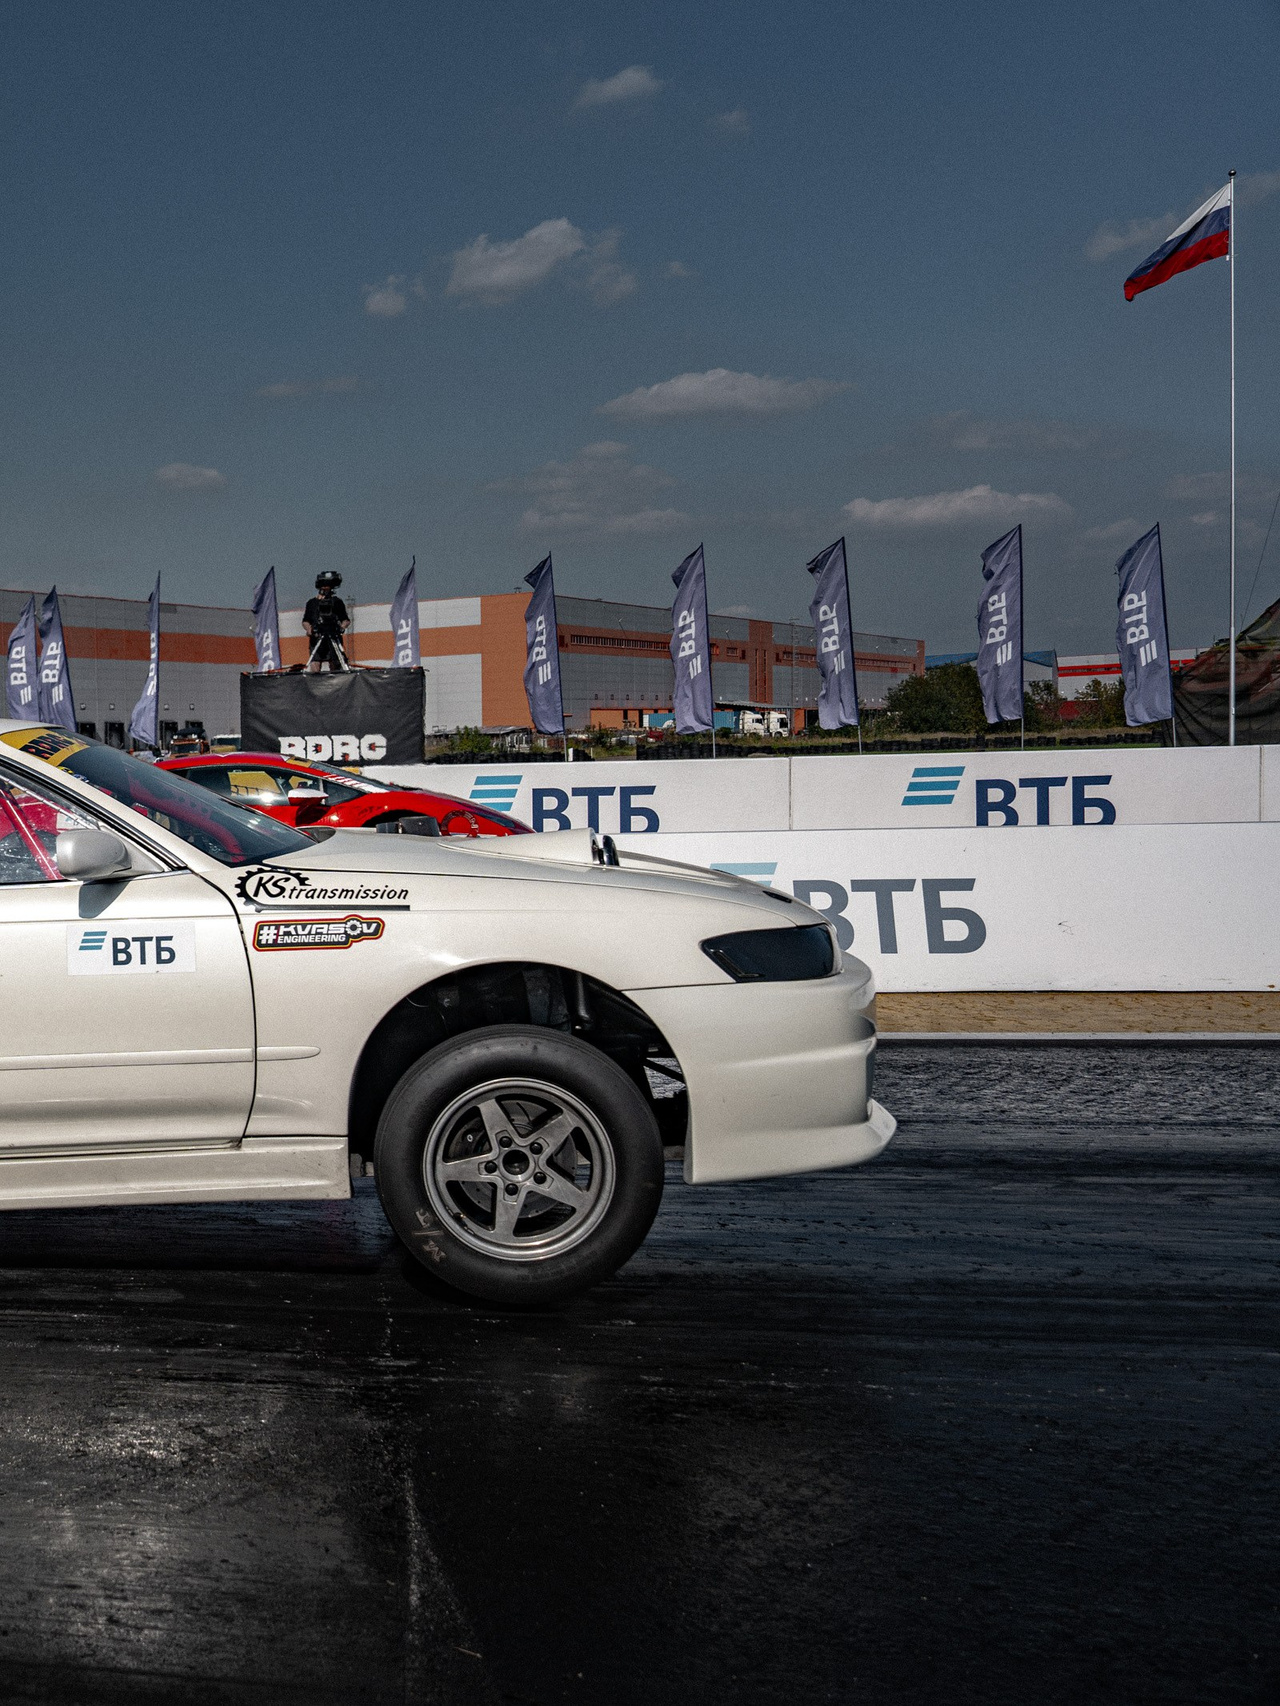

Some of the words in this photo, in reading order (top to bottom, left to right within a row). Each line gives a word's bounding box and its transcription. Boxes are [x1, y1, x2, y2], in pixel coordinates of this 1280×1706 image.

[278, 735, 387, 761] RDRC
[532, 785, 660, 834] ВТБ
[975, 775, 1117, 826] ВТБ
[792, 877, 987, 955] ВТБ
[112, 935, 176, 966] ВТБ
[277, 934, 346, 944] ENGINEERING
